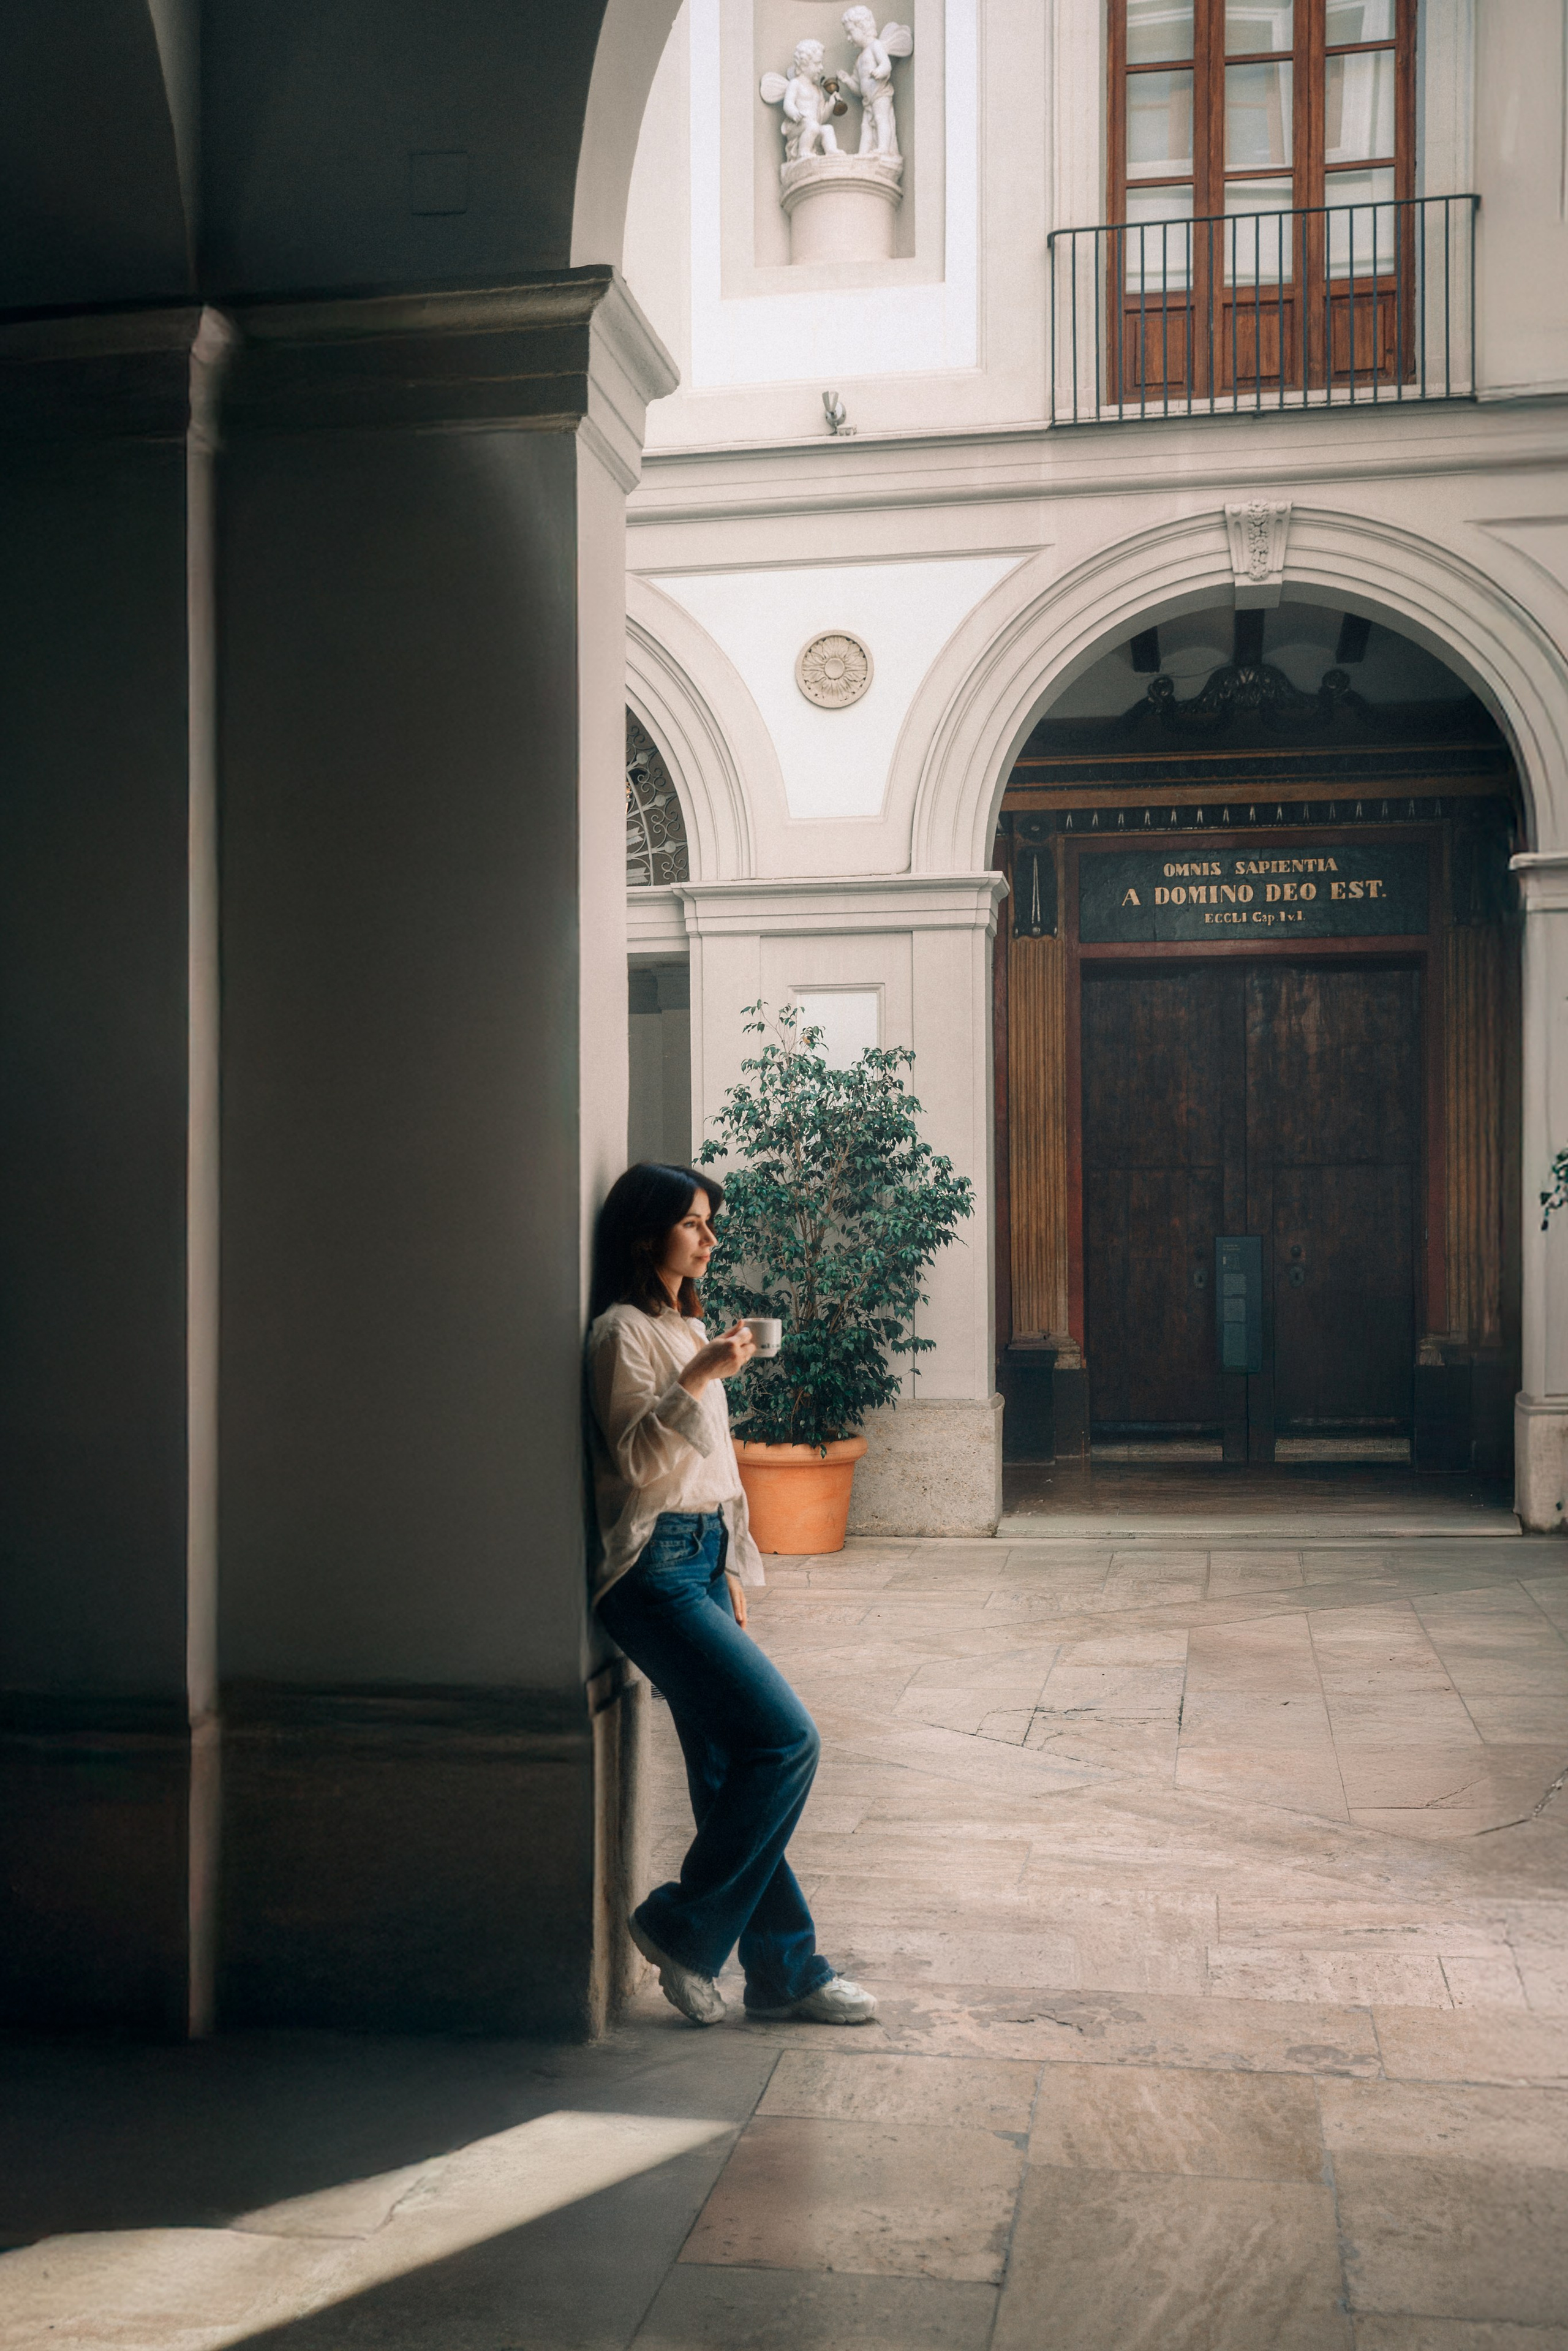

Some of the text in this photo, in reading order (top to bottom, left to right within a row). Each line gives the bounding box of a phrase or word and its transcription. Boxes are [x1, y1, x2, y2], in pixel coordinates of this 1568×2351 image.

[1163, 858, 1339, 877] OMNIS SAPIENTIA
[1121, 880, 1387, 906] A DOMINO DEO EST.
[1204, 912, 1247, 924] ECCLI
